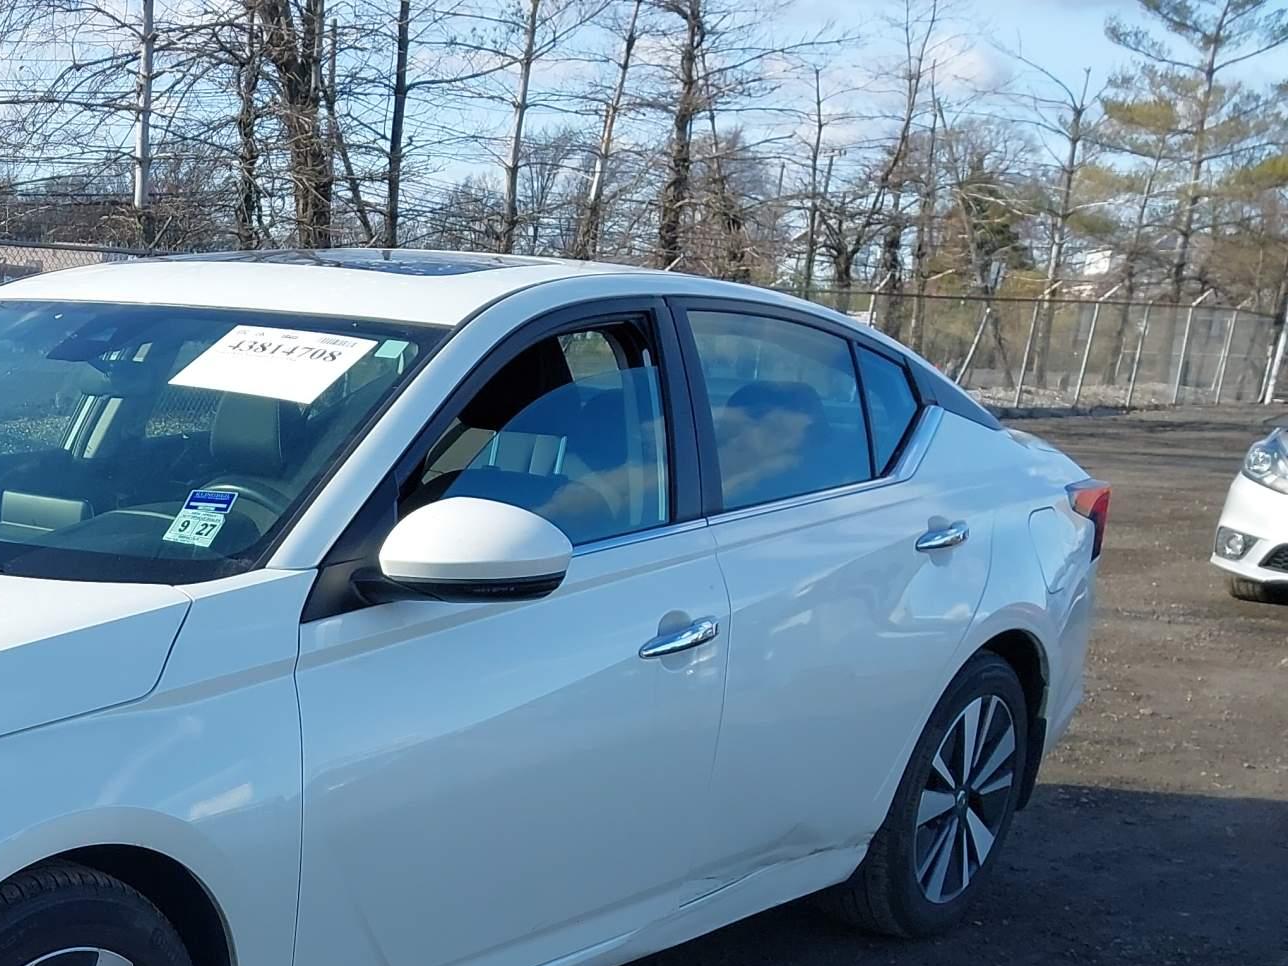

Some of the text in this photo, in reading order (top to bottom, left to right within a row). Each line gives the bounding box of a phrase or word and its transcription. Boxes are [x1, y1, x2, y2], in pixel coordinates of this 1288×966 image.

[228, 339, 342, 362] 43814708
[178, 519, 218, 537] 9 27
